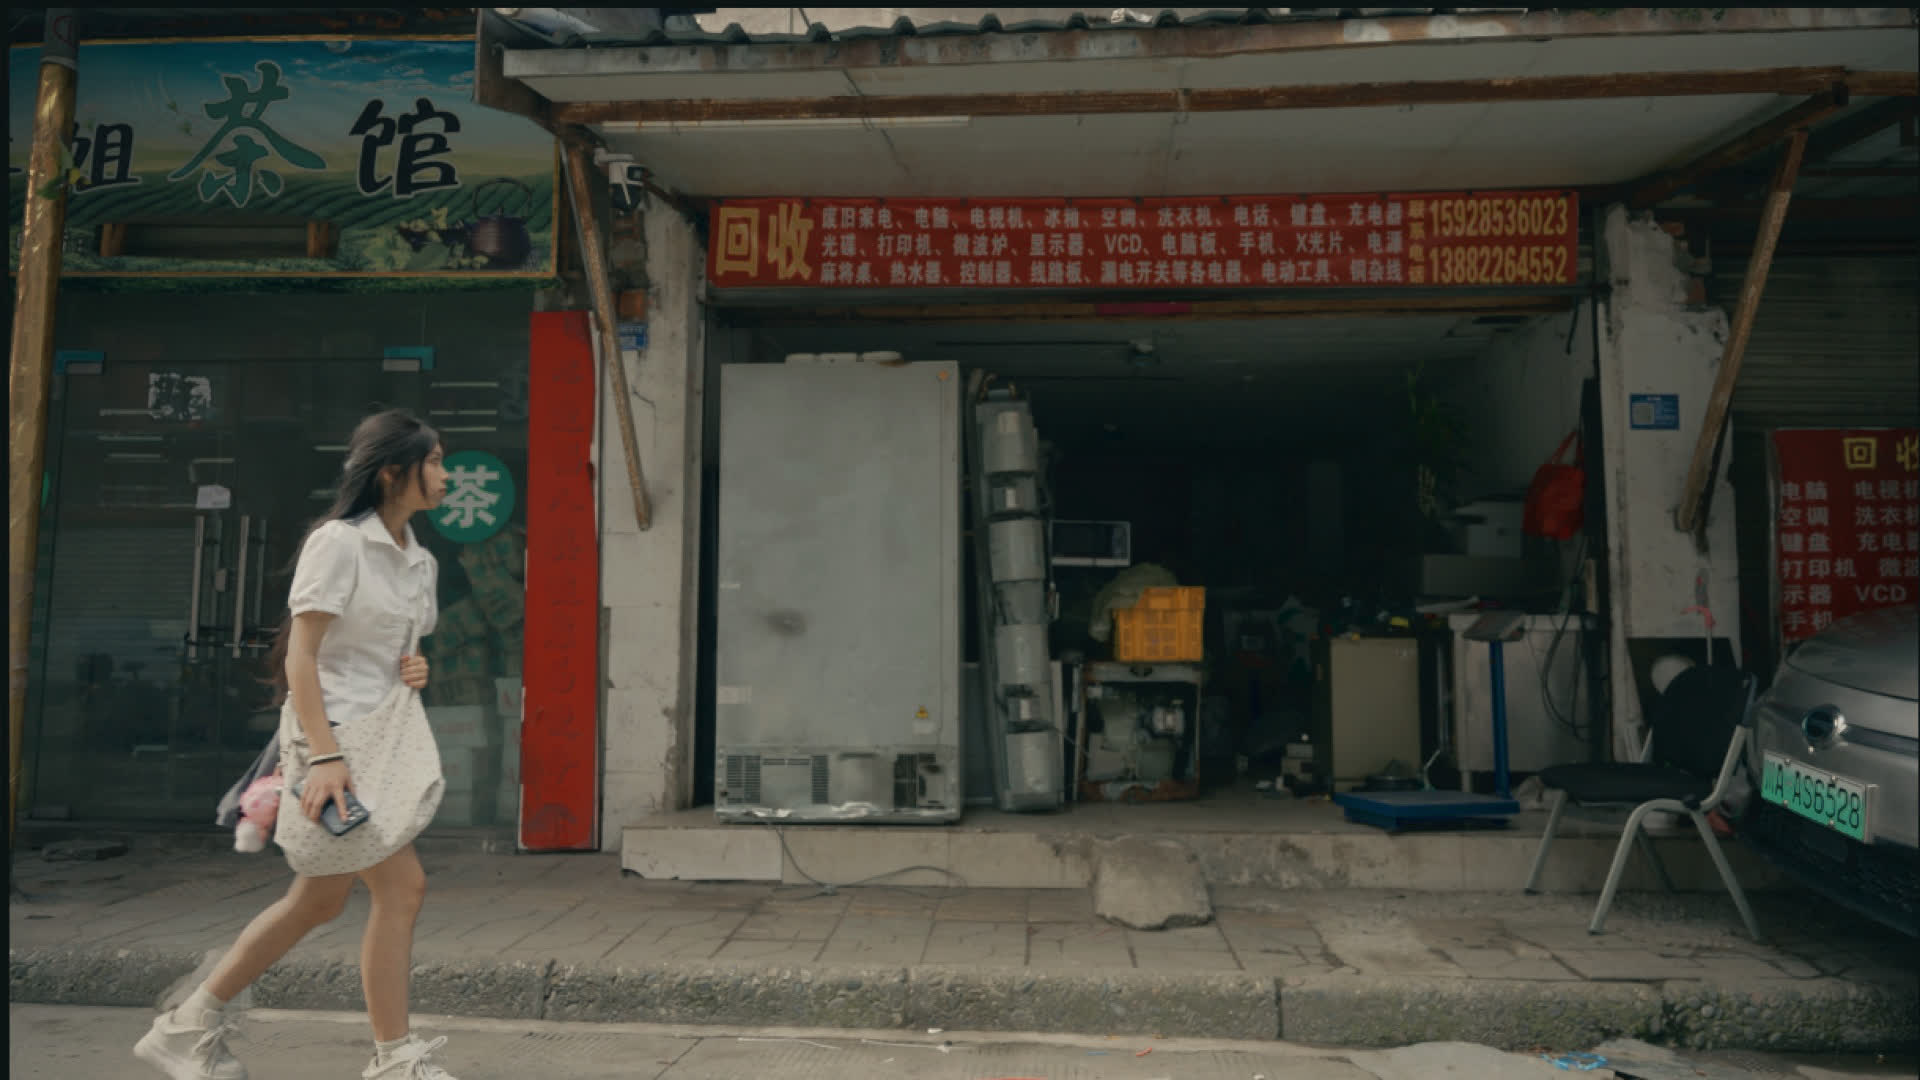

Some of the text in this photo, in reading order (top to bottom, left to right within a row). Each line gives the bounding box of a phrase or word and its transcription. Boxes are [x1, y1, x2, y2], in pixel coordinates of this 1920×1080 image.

[9, 59, 464, 207] 姐茶馆
[1429, 198, 1567, 237] 15928536023
[715, 203, 814, 280] 回收
[1429, 245, 1567, 284] 13882264552
[440, 465, 500, 529] 茶
[1781, 481, 1828, 501] 电脑
[1781, 506, 1830, 526] 空调
[1783, 558, 1857, 578] 打印机
[1783, 584, 1907, 604] 示器 VCD
[1783, 611, 1832, 632] 手机
